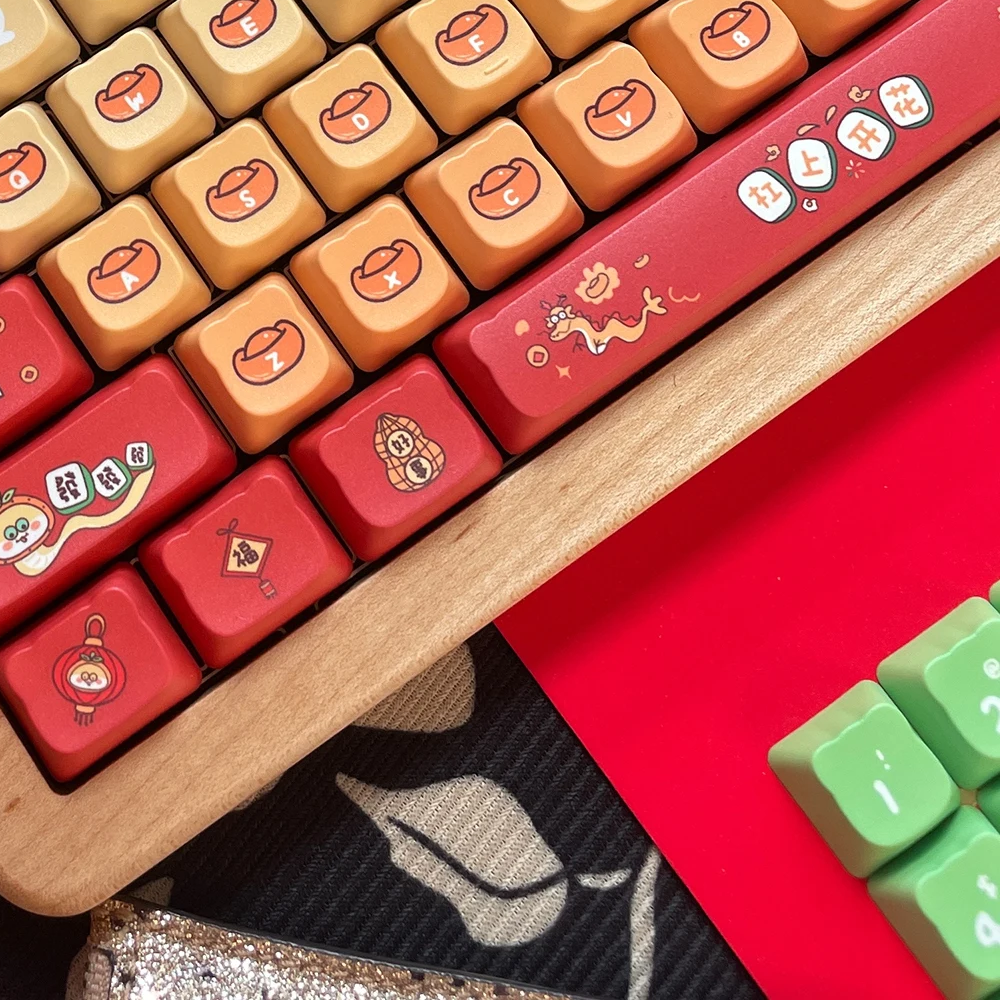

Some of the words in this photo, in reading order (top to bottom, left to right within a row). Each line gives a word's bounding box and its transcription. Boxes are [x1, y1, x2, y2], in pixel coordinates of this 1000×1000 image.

[240, 16, 259, 37] E
[468, 34, 484, 53] F
[732, 31, 751, 48] B
[124, 92, 144, 112] W
[351, 113, 370, 131] D
[616, 111, 632, 128] V
[748, 83, 924, 209] 杠上开花
[9, 170, 30, 189] Q
[239, 189, 256, 208] S
[503, 189, 520, 206] C
[121, 271, 139, 292] A
[383, 271, 401, 289] X
[265, 351, 284, 372] Z
[232, 540, 260, 568] 福
[873, 779, 899, 815] 1
